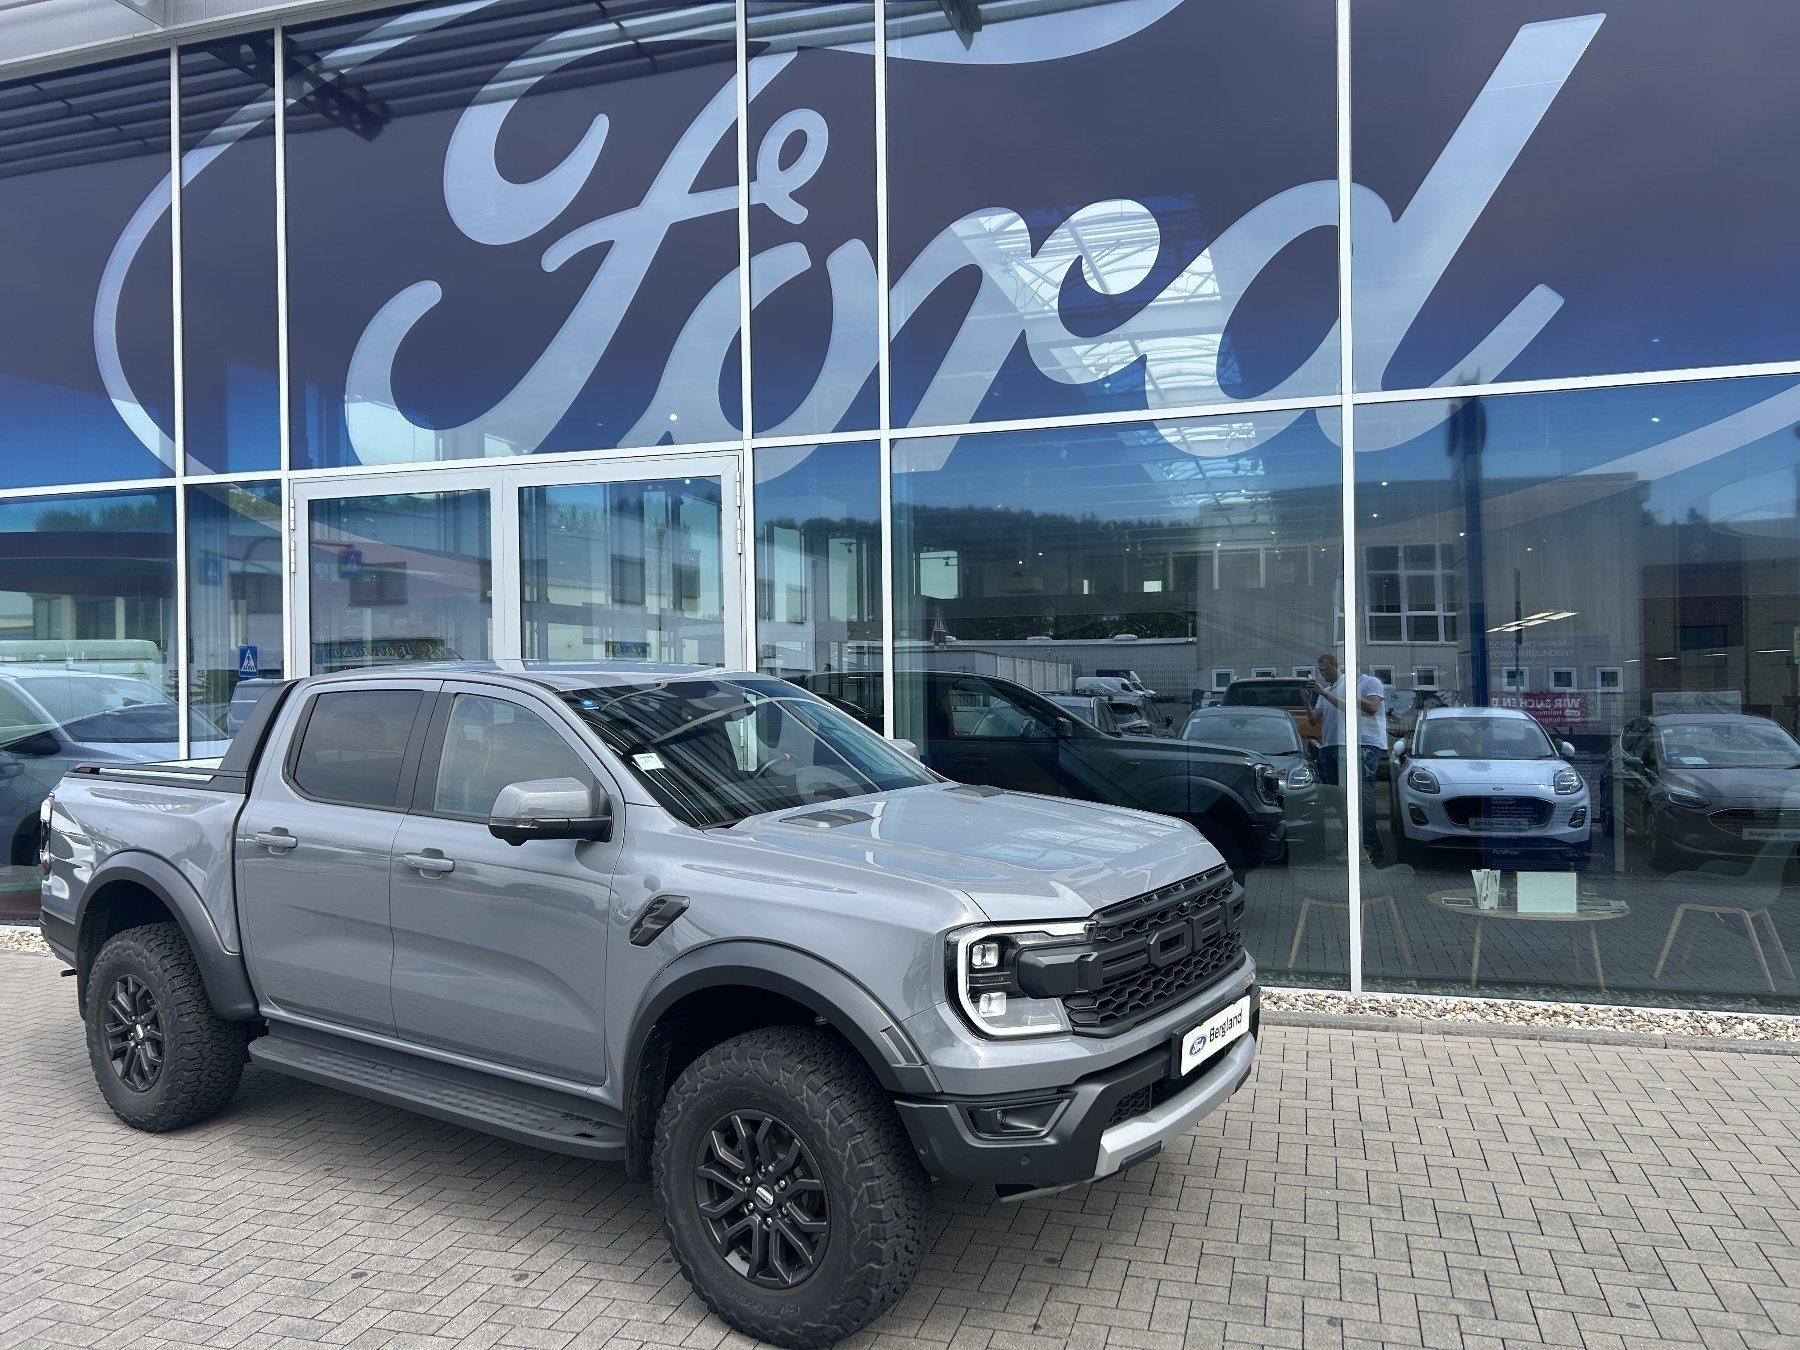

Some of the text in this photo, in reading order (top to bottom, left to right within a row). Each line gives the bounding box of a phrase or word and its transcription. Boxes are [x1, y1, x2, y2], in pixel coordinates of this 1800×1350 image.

[346, 0, 1606, 484] Ford
[1076, 896, 1245, 992] FORD
[1209, 1007, 1243, 1042] Bergland
